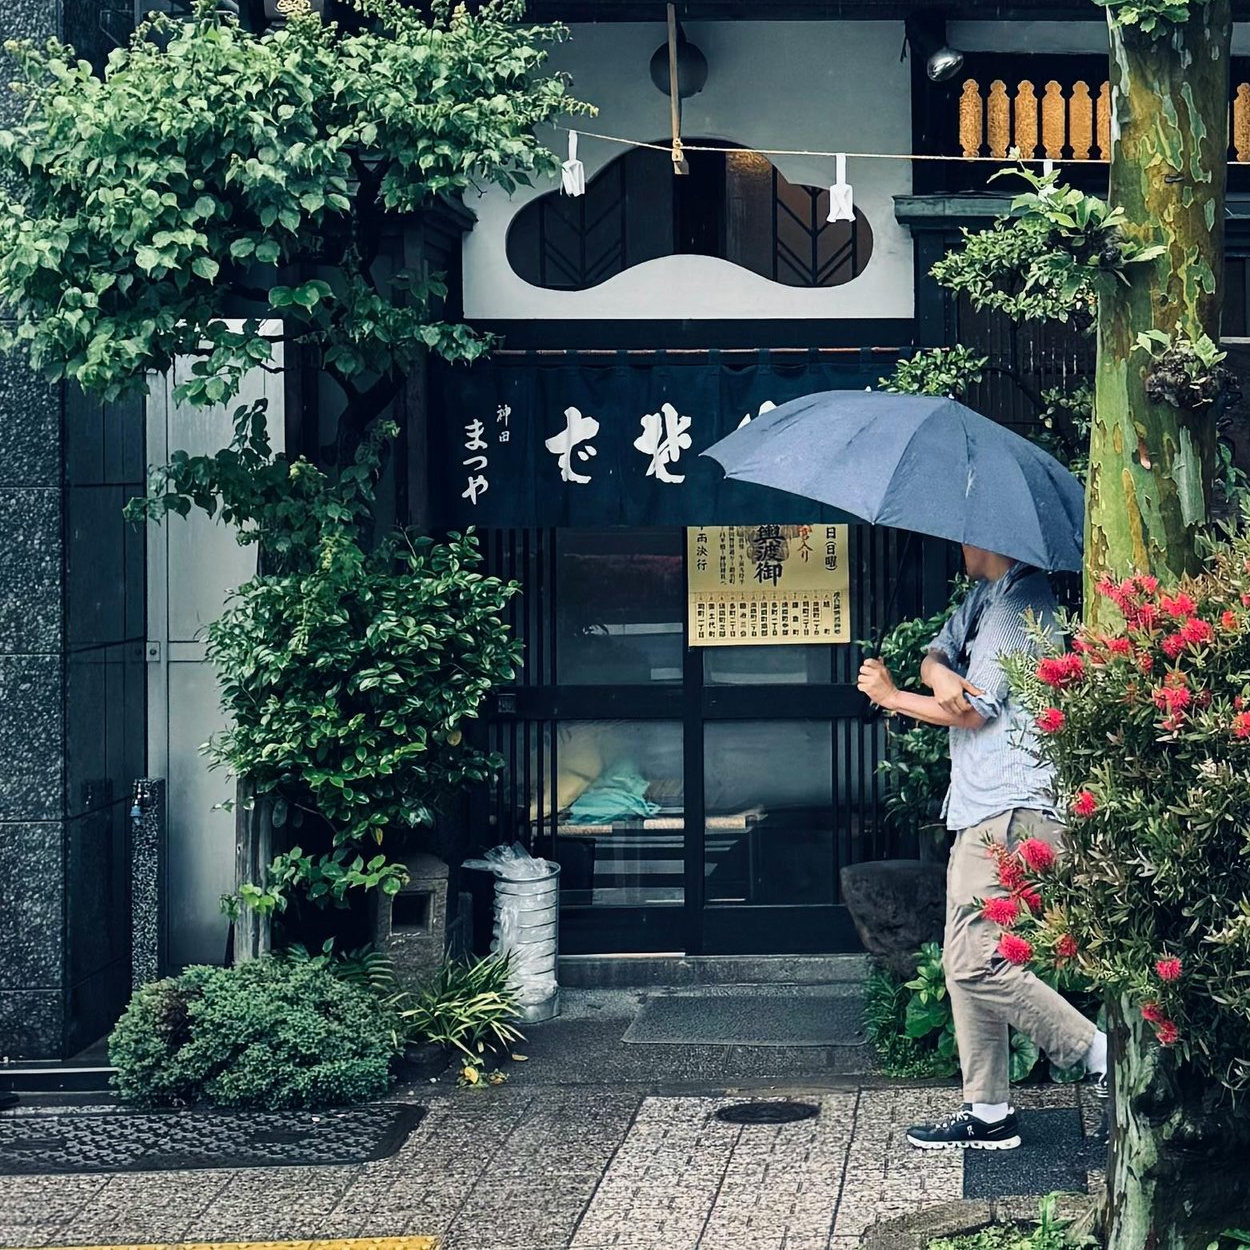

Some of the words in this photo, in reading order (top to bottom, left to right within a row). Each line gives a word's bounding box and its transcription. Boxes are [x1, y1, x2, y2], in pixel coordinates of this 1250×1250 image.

[495, 403, 512, 444] 神田
[461, 418, 489, 505] まつや
[696, 527, 708, 571] 雨決行
